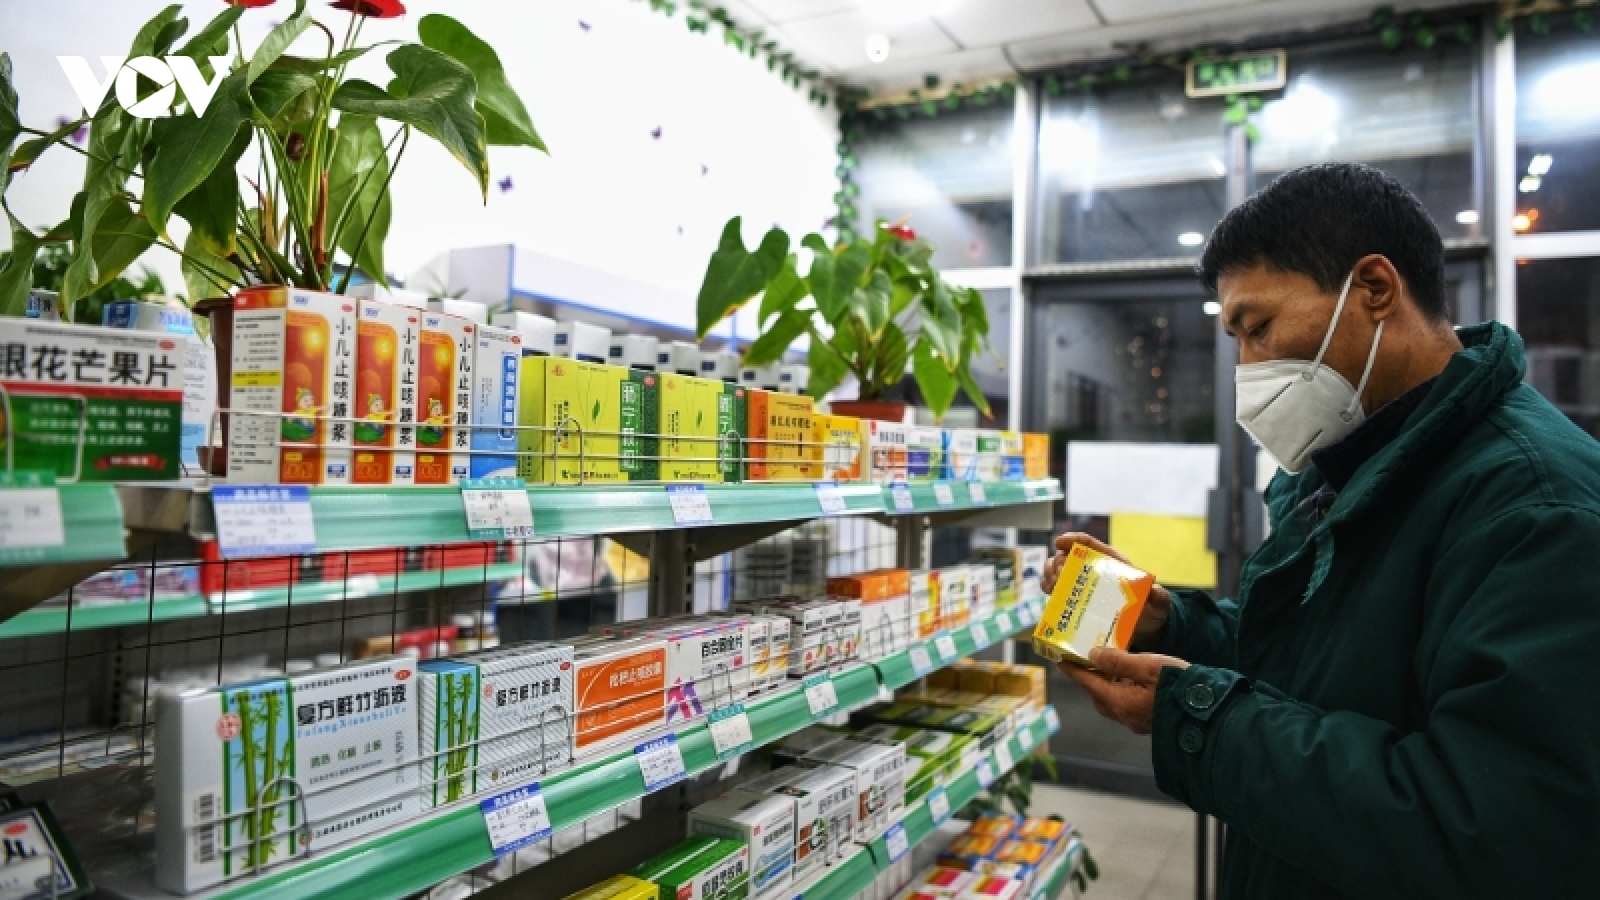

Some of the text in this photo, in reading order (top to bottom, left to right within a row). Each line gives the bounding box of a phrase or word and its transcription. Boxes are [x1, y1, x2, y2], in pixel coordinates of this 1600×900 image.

[331, 316, 351, 442] 小儿止咳糖浆
[398, 328, 416, 446] 小儿止咳糖浆
[297, 684, 407, 726] 复方鲜竹沥液
[496, 675, 561, 707] 复方鲜竹沥液
